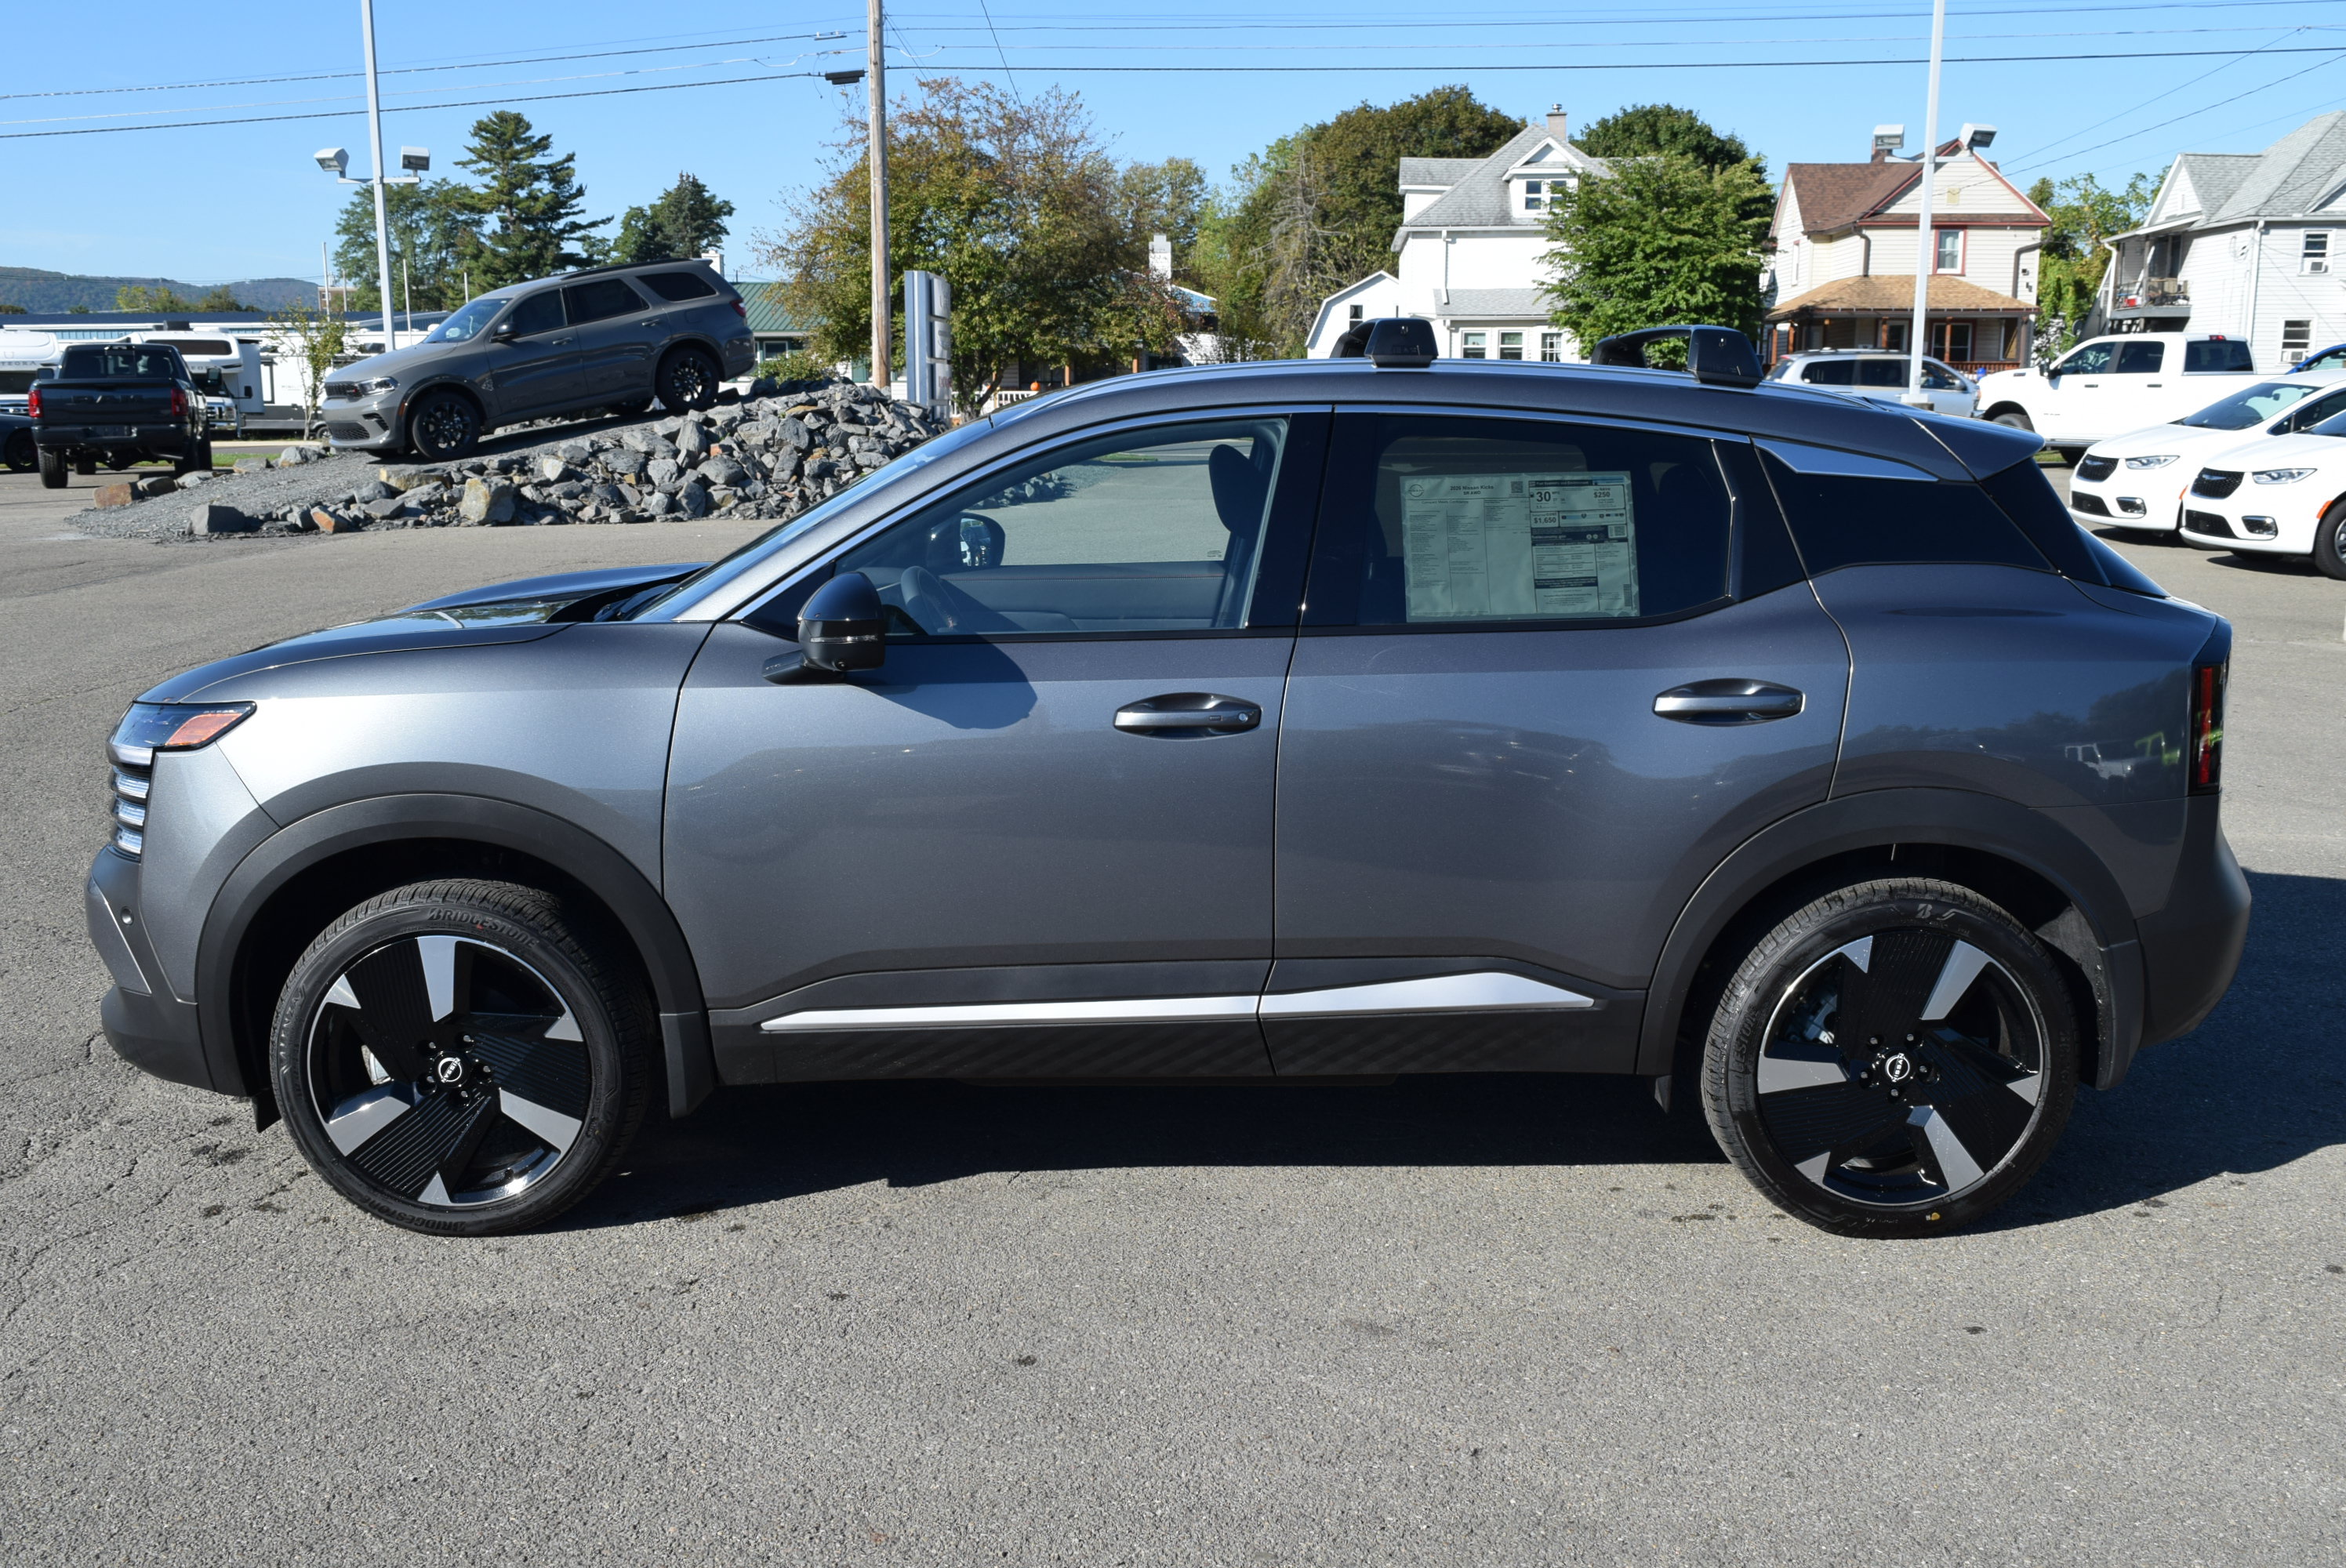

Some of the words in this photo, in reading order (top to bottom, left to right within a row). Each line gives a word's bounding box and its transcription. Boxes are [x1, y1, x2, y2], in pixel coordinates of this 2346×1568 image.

[1536, 492, 1551, 503] 30
[427, 906, 539, 948] BRIDGESTONE
[441, 1057, 461, 1083] NISSAN
[1891, 1052, 1905, 1083] NISSAN
[358, 1195, 467, 1233] BRIDGESTONE
